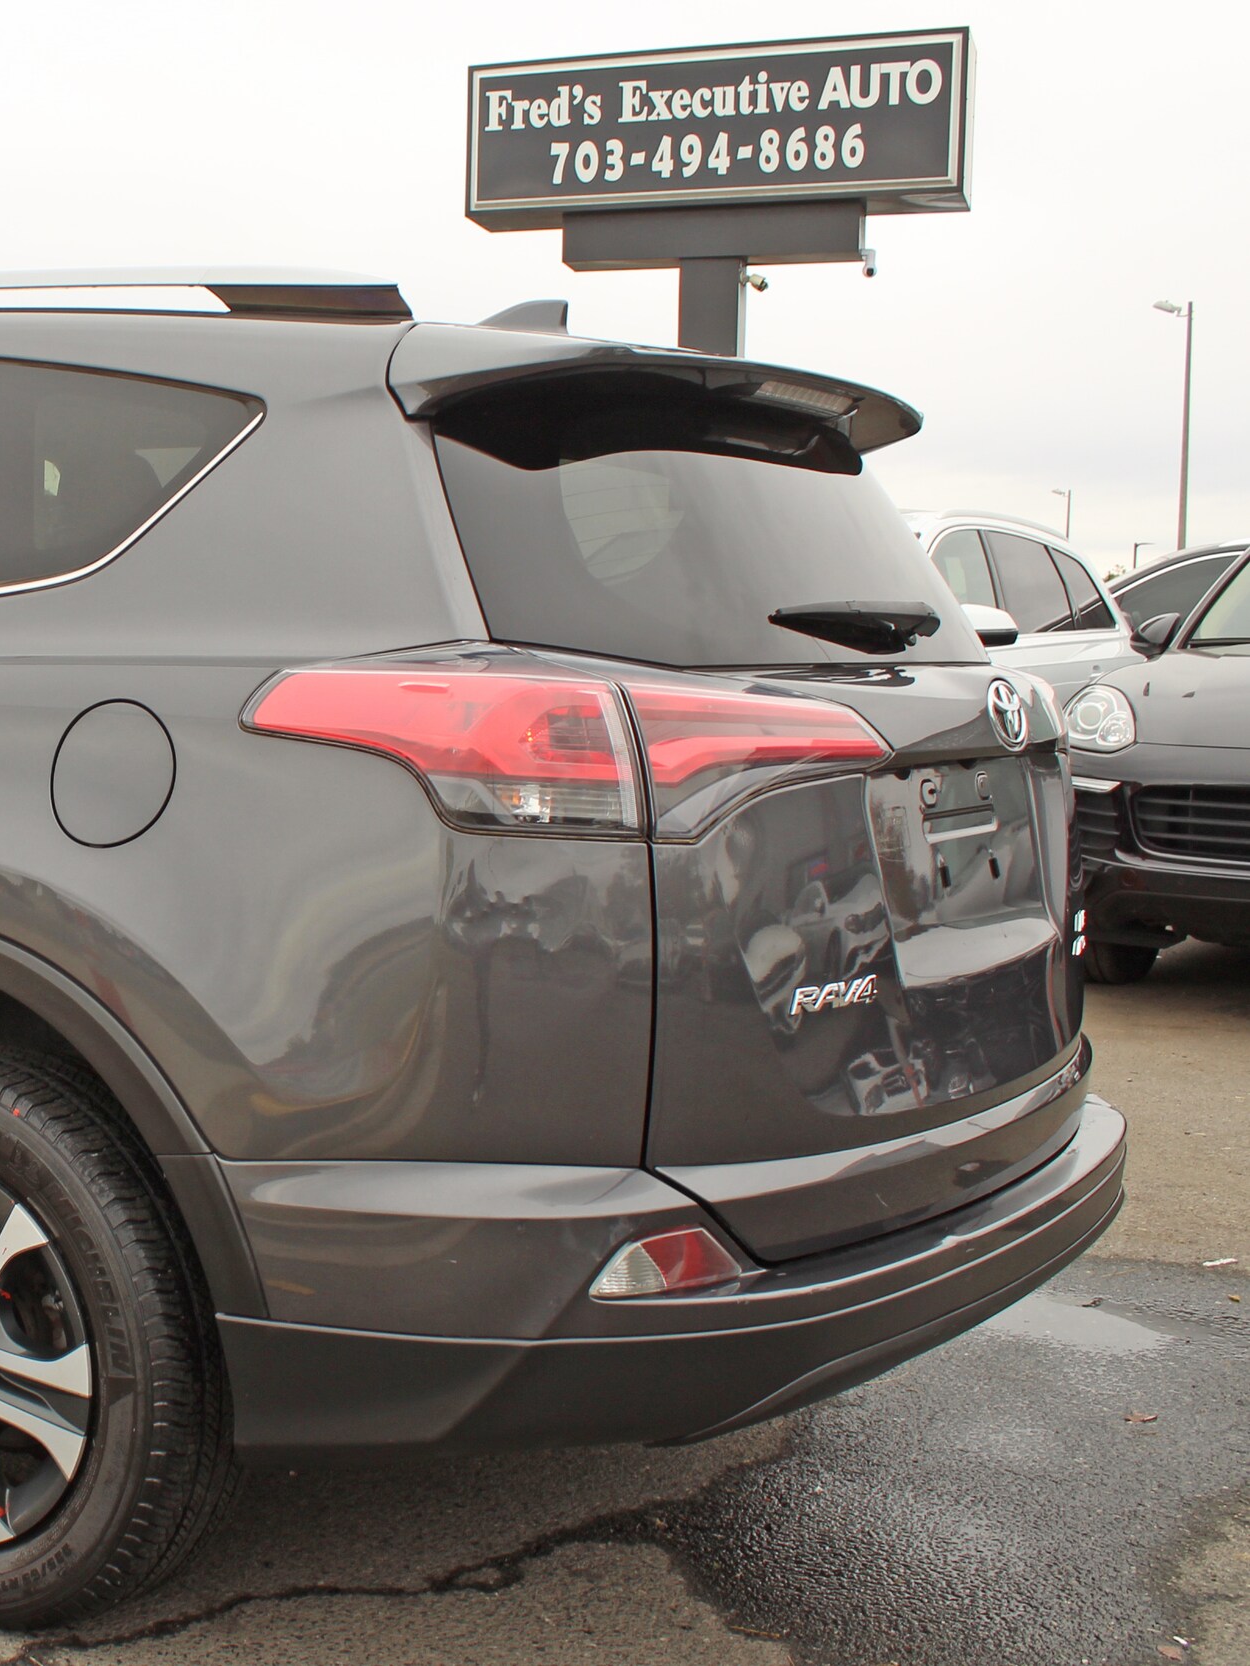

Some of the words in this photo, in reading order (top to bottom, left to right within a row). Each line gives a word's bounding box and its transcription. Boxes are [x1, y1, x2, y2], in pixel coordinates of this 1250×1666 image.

[484, 84, 602, 132] Fred's
[618, 71, 810, 125] Executive
[818, 58, 943, 111] AUTO
[550, 123, 866, 185] 703-494-8686
[789, 973, 878, 1016] RAV4
